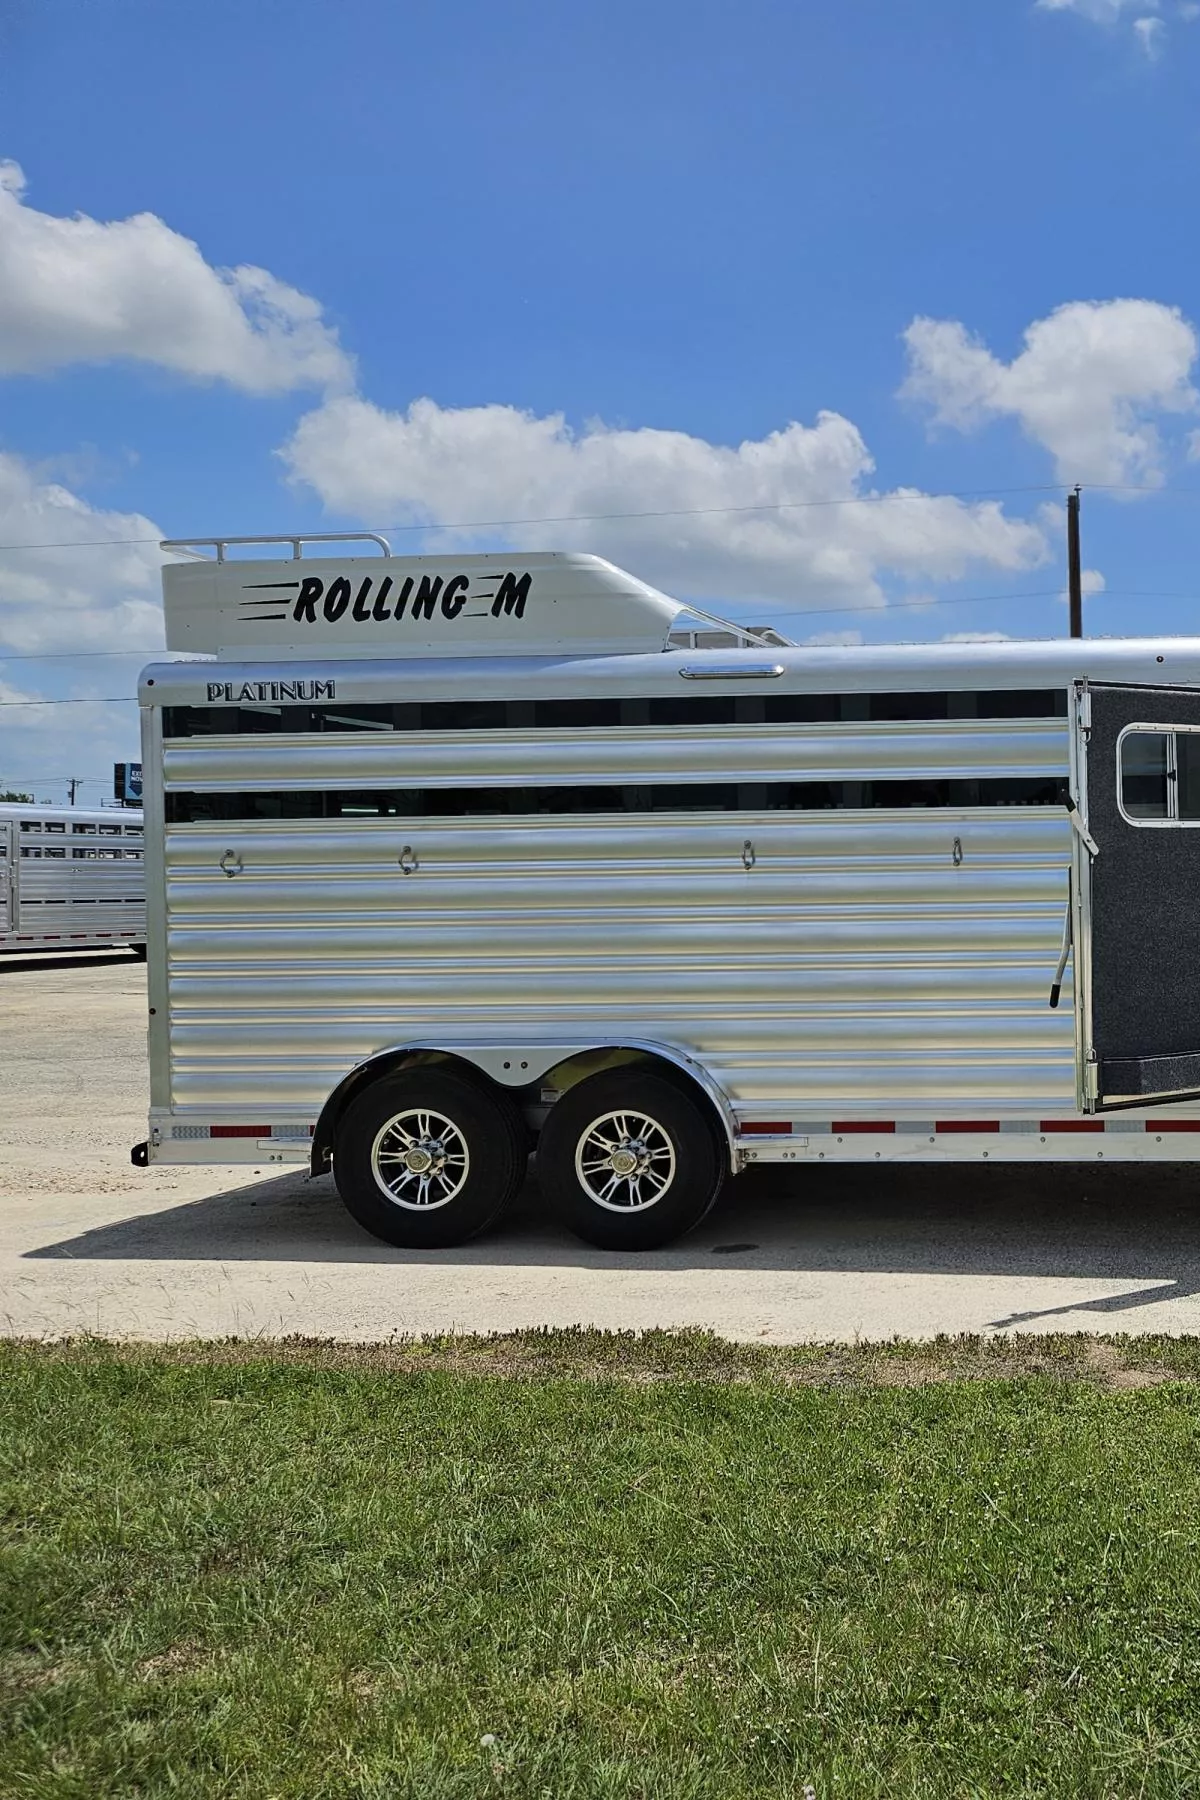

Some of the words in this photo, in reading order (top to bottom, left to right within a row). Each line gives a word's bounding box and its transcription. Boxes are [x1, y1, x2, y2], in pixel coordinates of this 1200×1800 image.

[293, 574, 470, 623] ROLLING
[491, 572, 533, 619] M
[206, 680, 335, 702] PLATINUM
